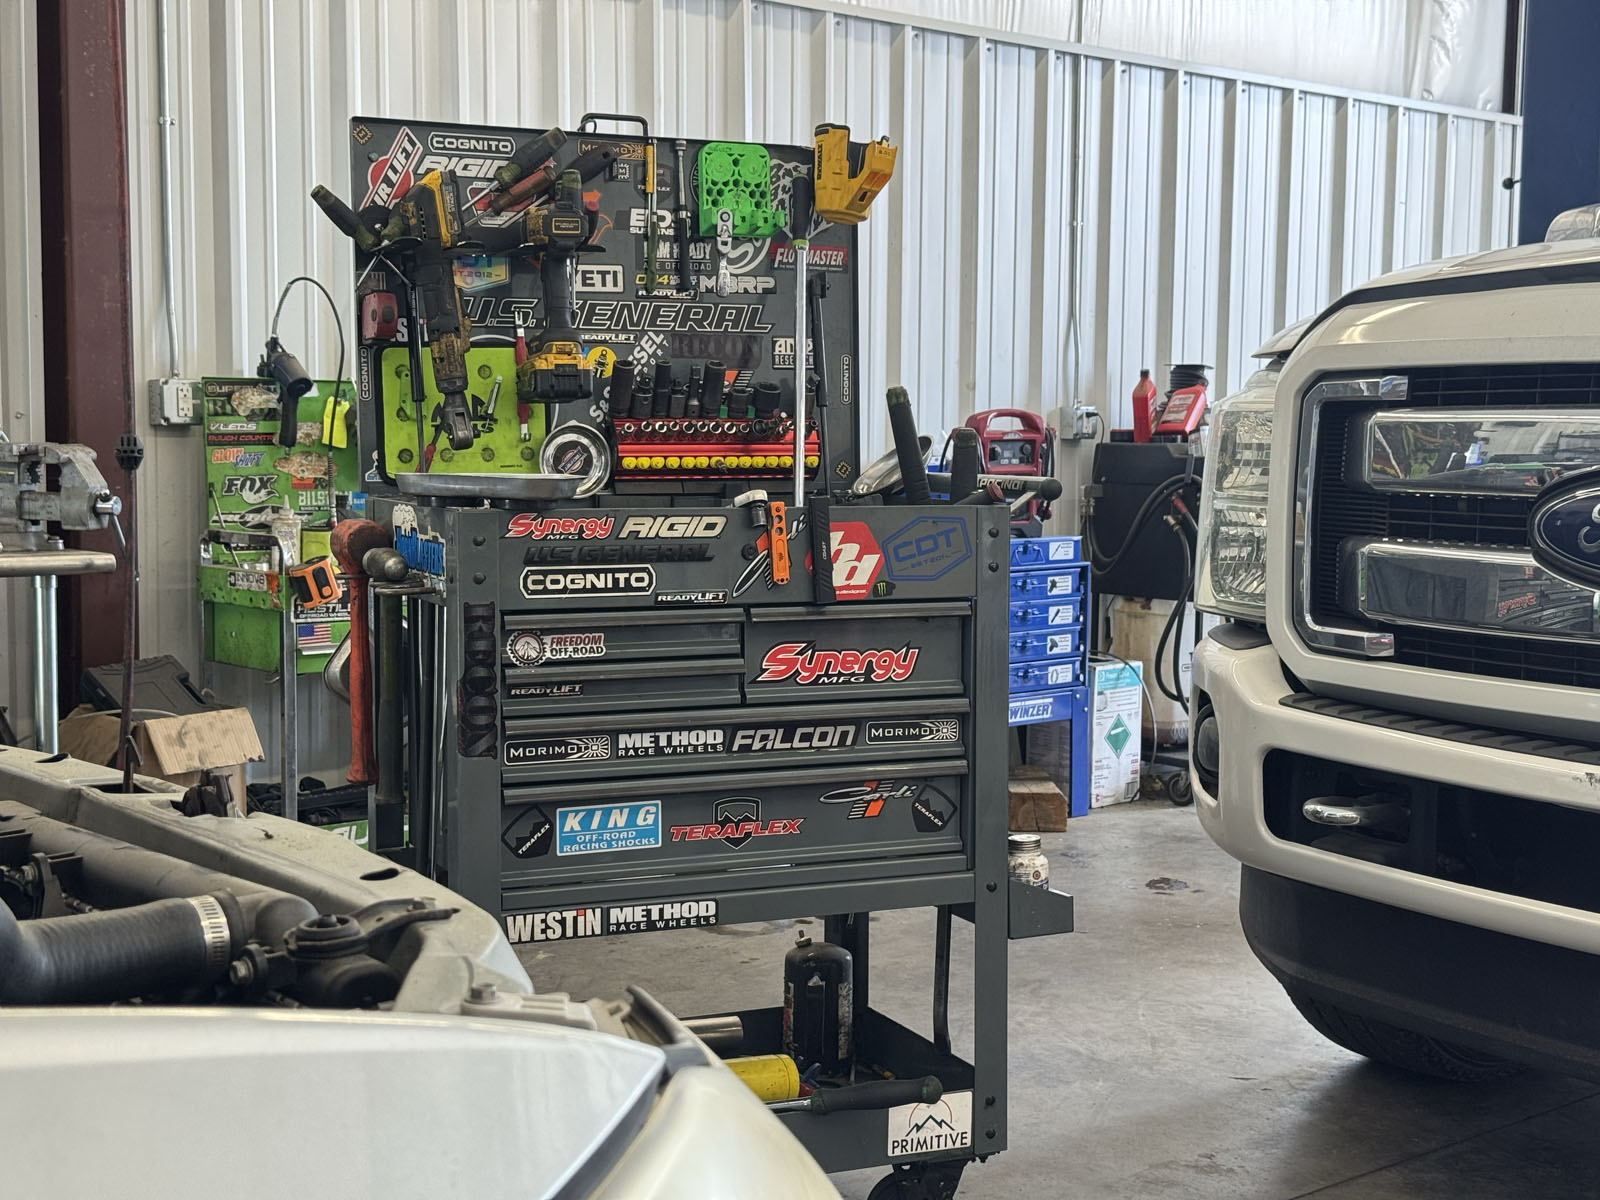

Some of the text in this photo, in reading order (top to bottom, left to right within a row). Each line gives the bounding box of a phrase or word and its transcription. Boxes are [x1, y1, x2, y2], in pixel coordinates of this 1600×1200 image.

[432, 137, 512, 152] COGNITO
[386, 136, 414, 184] LIFT
[774, 248, 844, 268] FLOMASTER
[463, 296, 538, 327] U.S.
[774, 355, 813, 365] RESECH
[361, 349, 369, 399] COGNITO
[223, 475, 279, 503] FOX
[505, 513, 614, 539] Synergy
[618, 516, 727, 538] RIGID
[893, 527, 957, 562] CDT
[527, 573, 649, 591] COGNITO
[657, 592, 725, 602] READYLIFT
[550, 633, 603, 647] FREEDOM
[550, 646, 604, 659] OFF-ROAD
[756, 642, 919, 684] Synergy
[511, 684, 582, 695] READYLIFT
[818, 676, 866, 684] MFG
[1010, 703, 1050, 720] WINZER
[618, 729, 724, 748] METHOD
[733, 725, 856, 751] FALCON
[618, 744, 724, 757] RACE WHEELS
[563, 805, 657, 833] KING
[914, 802, 944, 827] TERAFLEX
[517, 823, 551, 856] TERAFLEX
[576, 830, 636, 843] OFF-ROAD
[670, 818, 804, 842] TERAFLEX
[563, 837, 656, 853] RACING SHOCKS
[609, 900, 716, 924] METHOD
[609, 916, 717, 932] RACE WHEELS
[891, 1131, 968, 1155] PRIMITIVE
